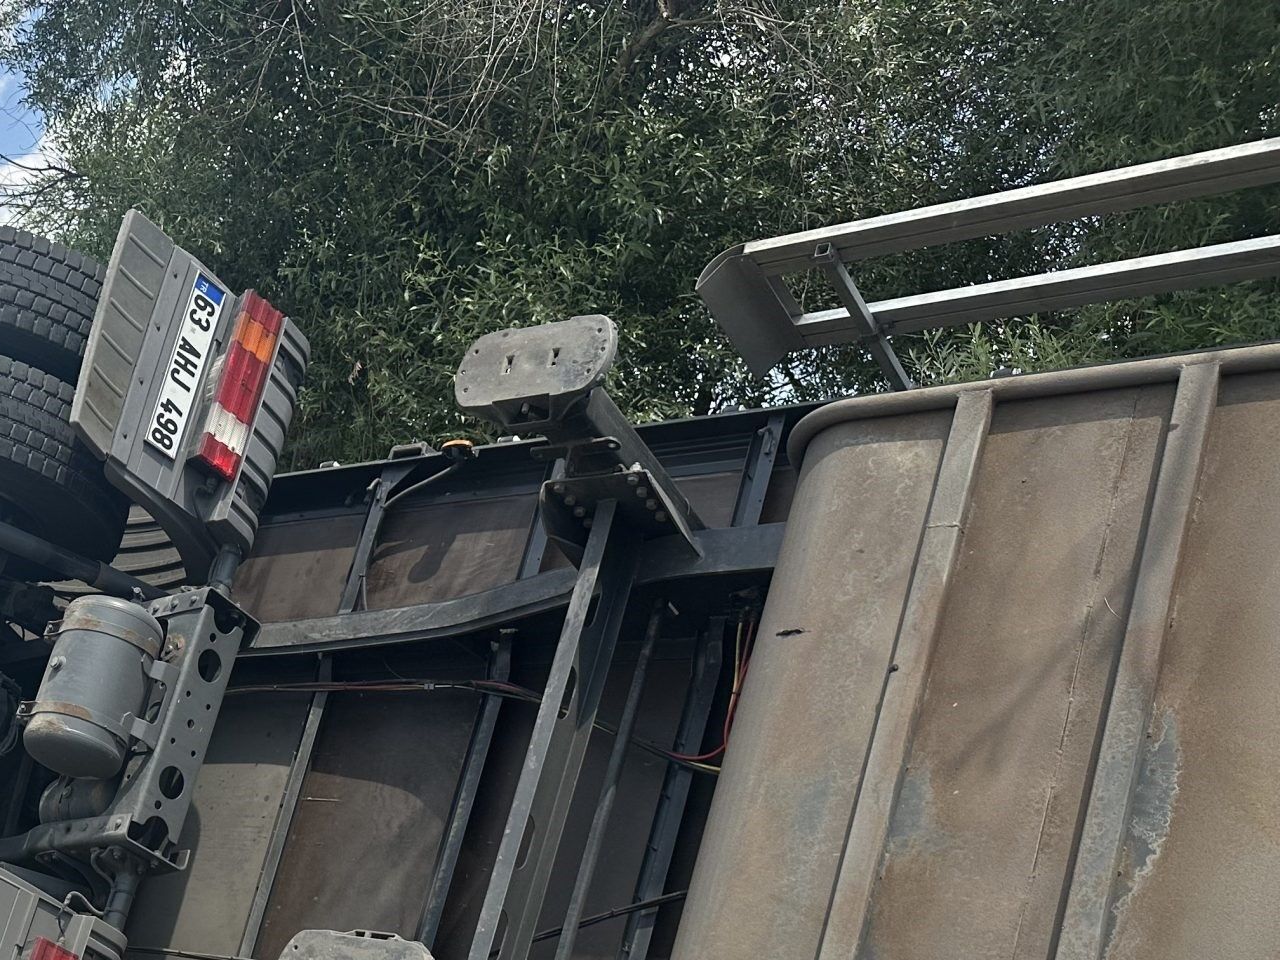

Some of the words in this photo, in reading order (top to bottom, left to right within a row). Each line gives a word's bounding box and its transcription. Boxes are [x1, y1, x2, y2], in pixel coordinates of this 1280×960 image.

[200, 281, 209, 292] TR
[189, 294, 215, 332] 63
[170, 337, 202, 392] AHJ
[151, 398, 183, 450] 498
